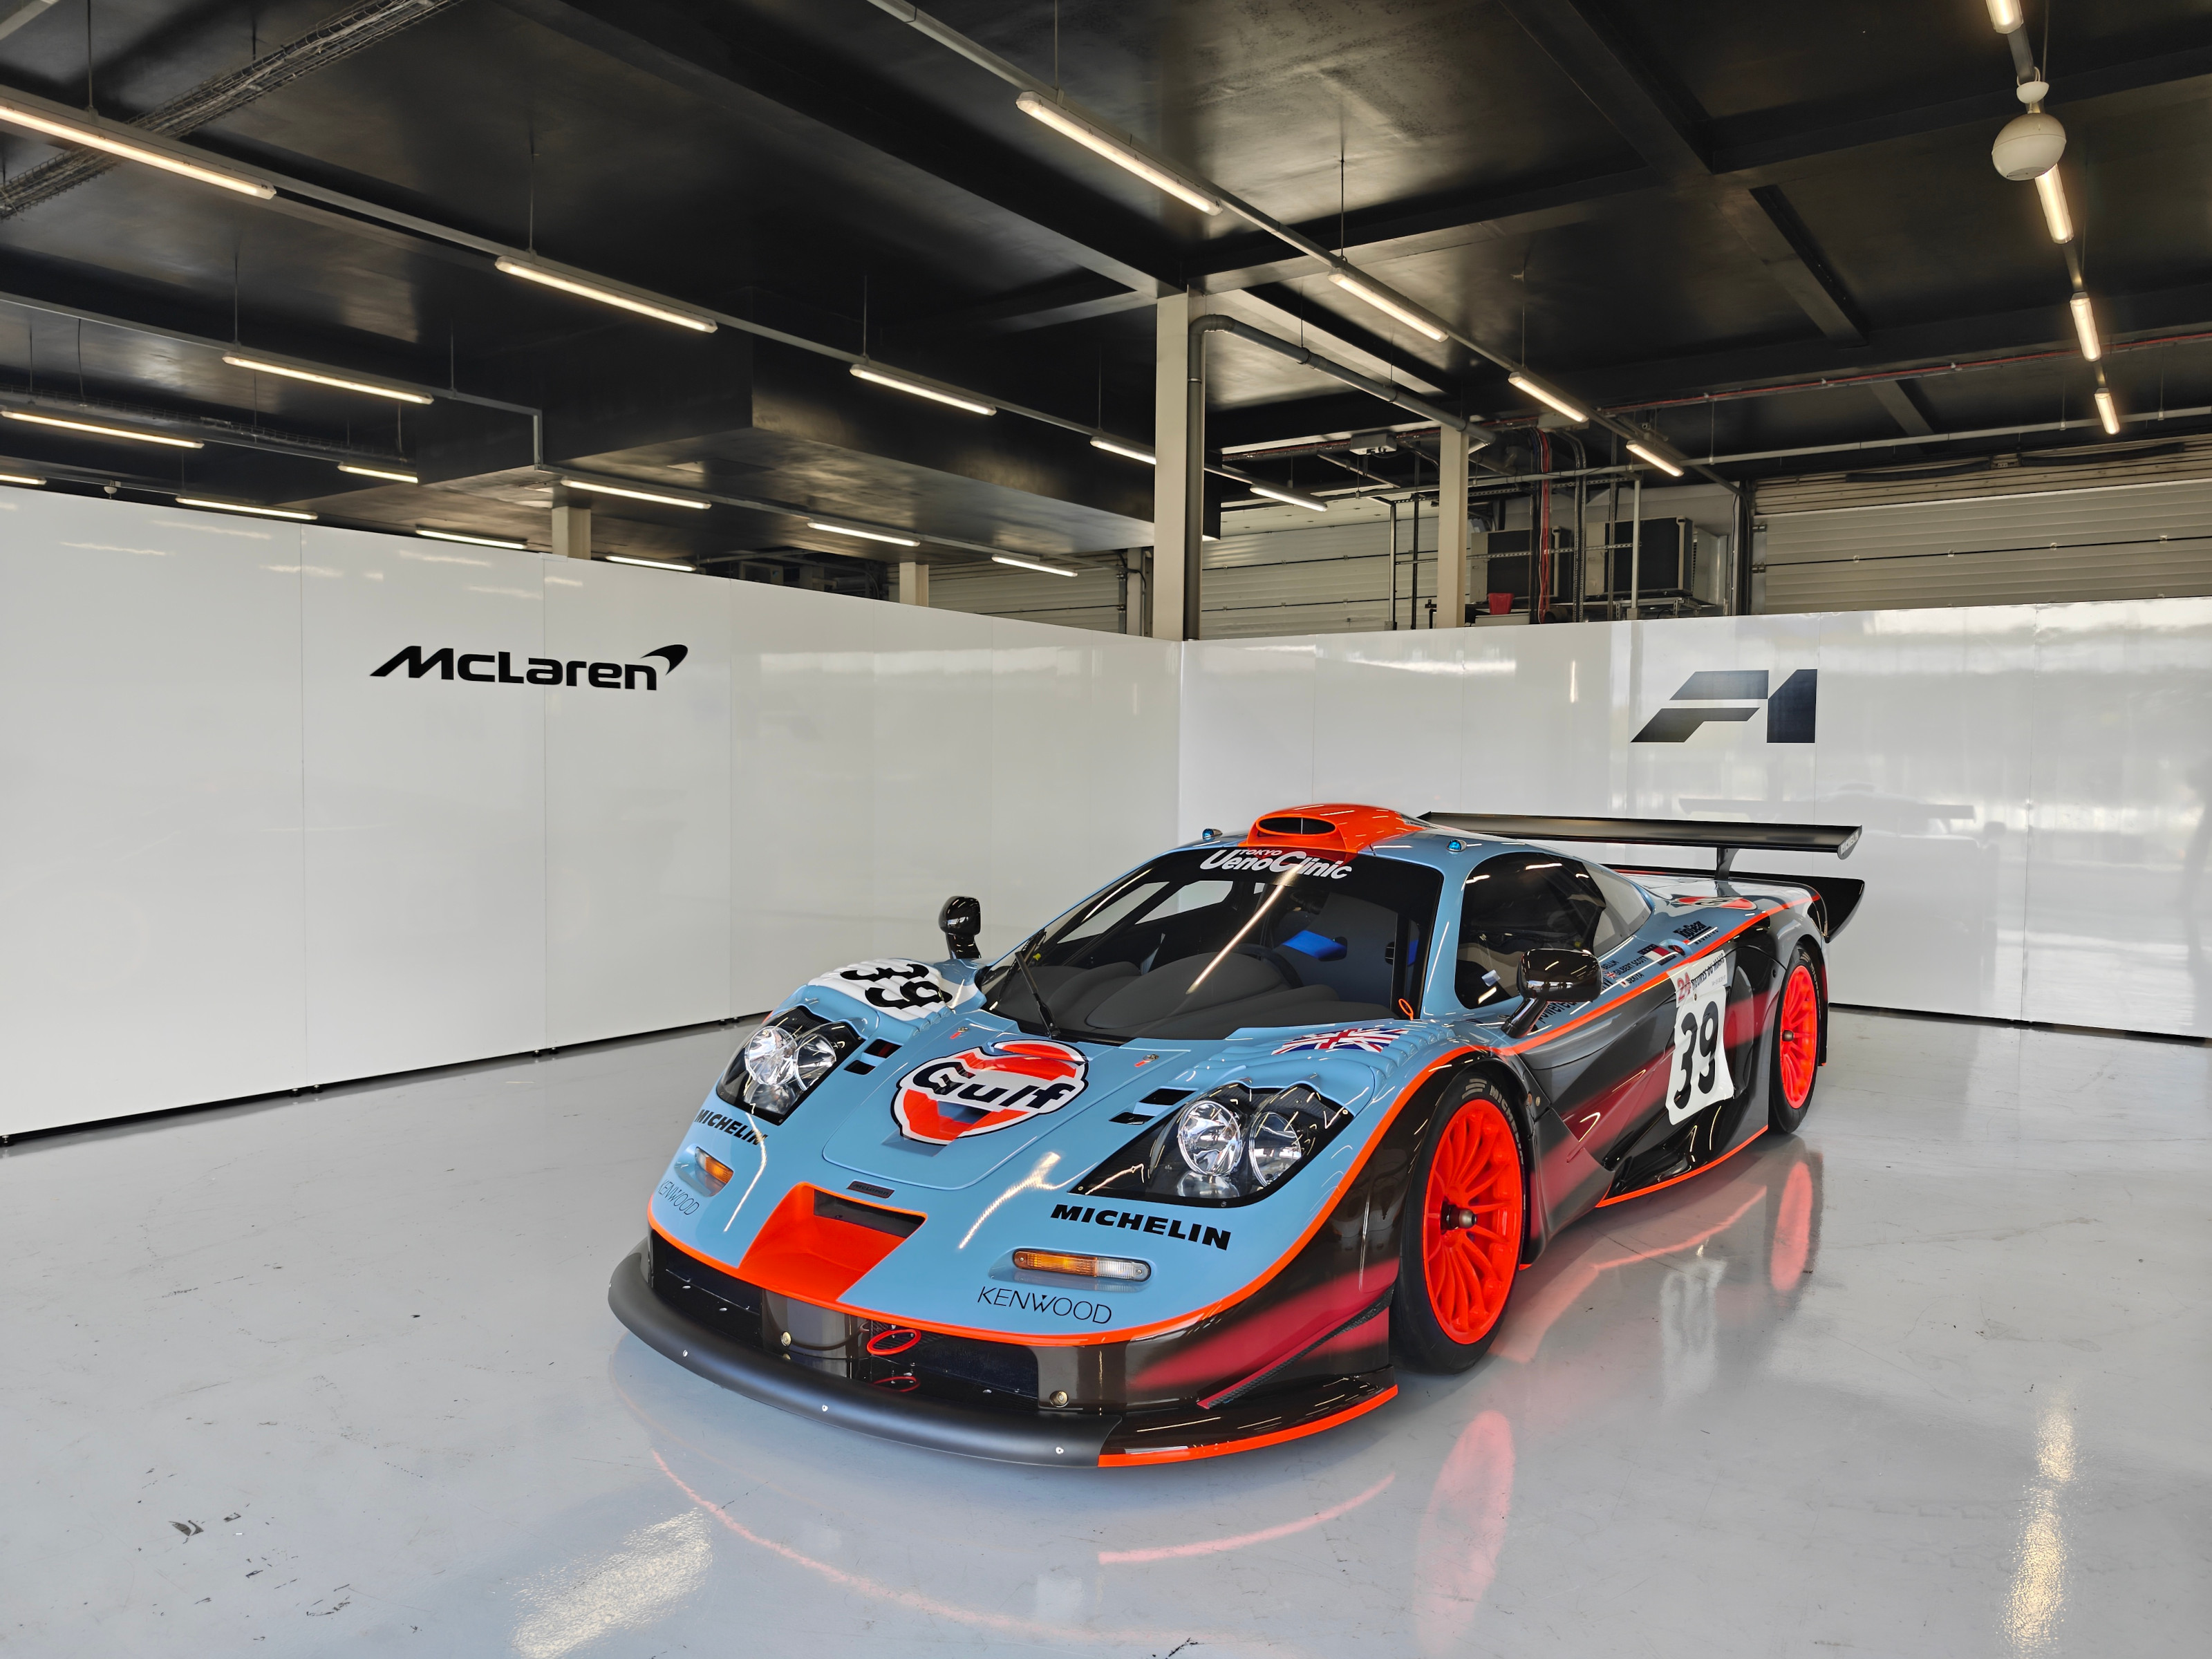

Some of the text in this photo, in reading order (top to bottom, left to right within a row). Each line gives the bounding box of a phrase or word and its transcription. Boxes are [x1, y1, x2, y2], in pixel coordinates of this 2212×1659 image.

[369, 646, 657, 691] McLaren
[1630, 668, 1817, 743] F1
[1631, 955, 1649, 966] SCOTT
[840, 964, 953, 1009] 39
[1674, 1001, 1721, 1109] 39
[911, 1060, 1076, 1113] Gulf
[694, 1109, 769, 1145] MICHELIN
[1050, 1203, 1232, 1250] MICHELIN
[977, 1285, 1113, 1325] KENWOOD
